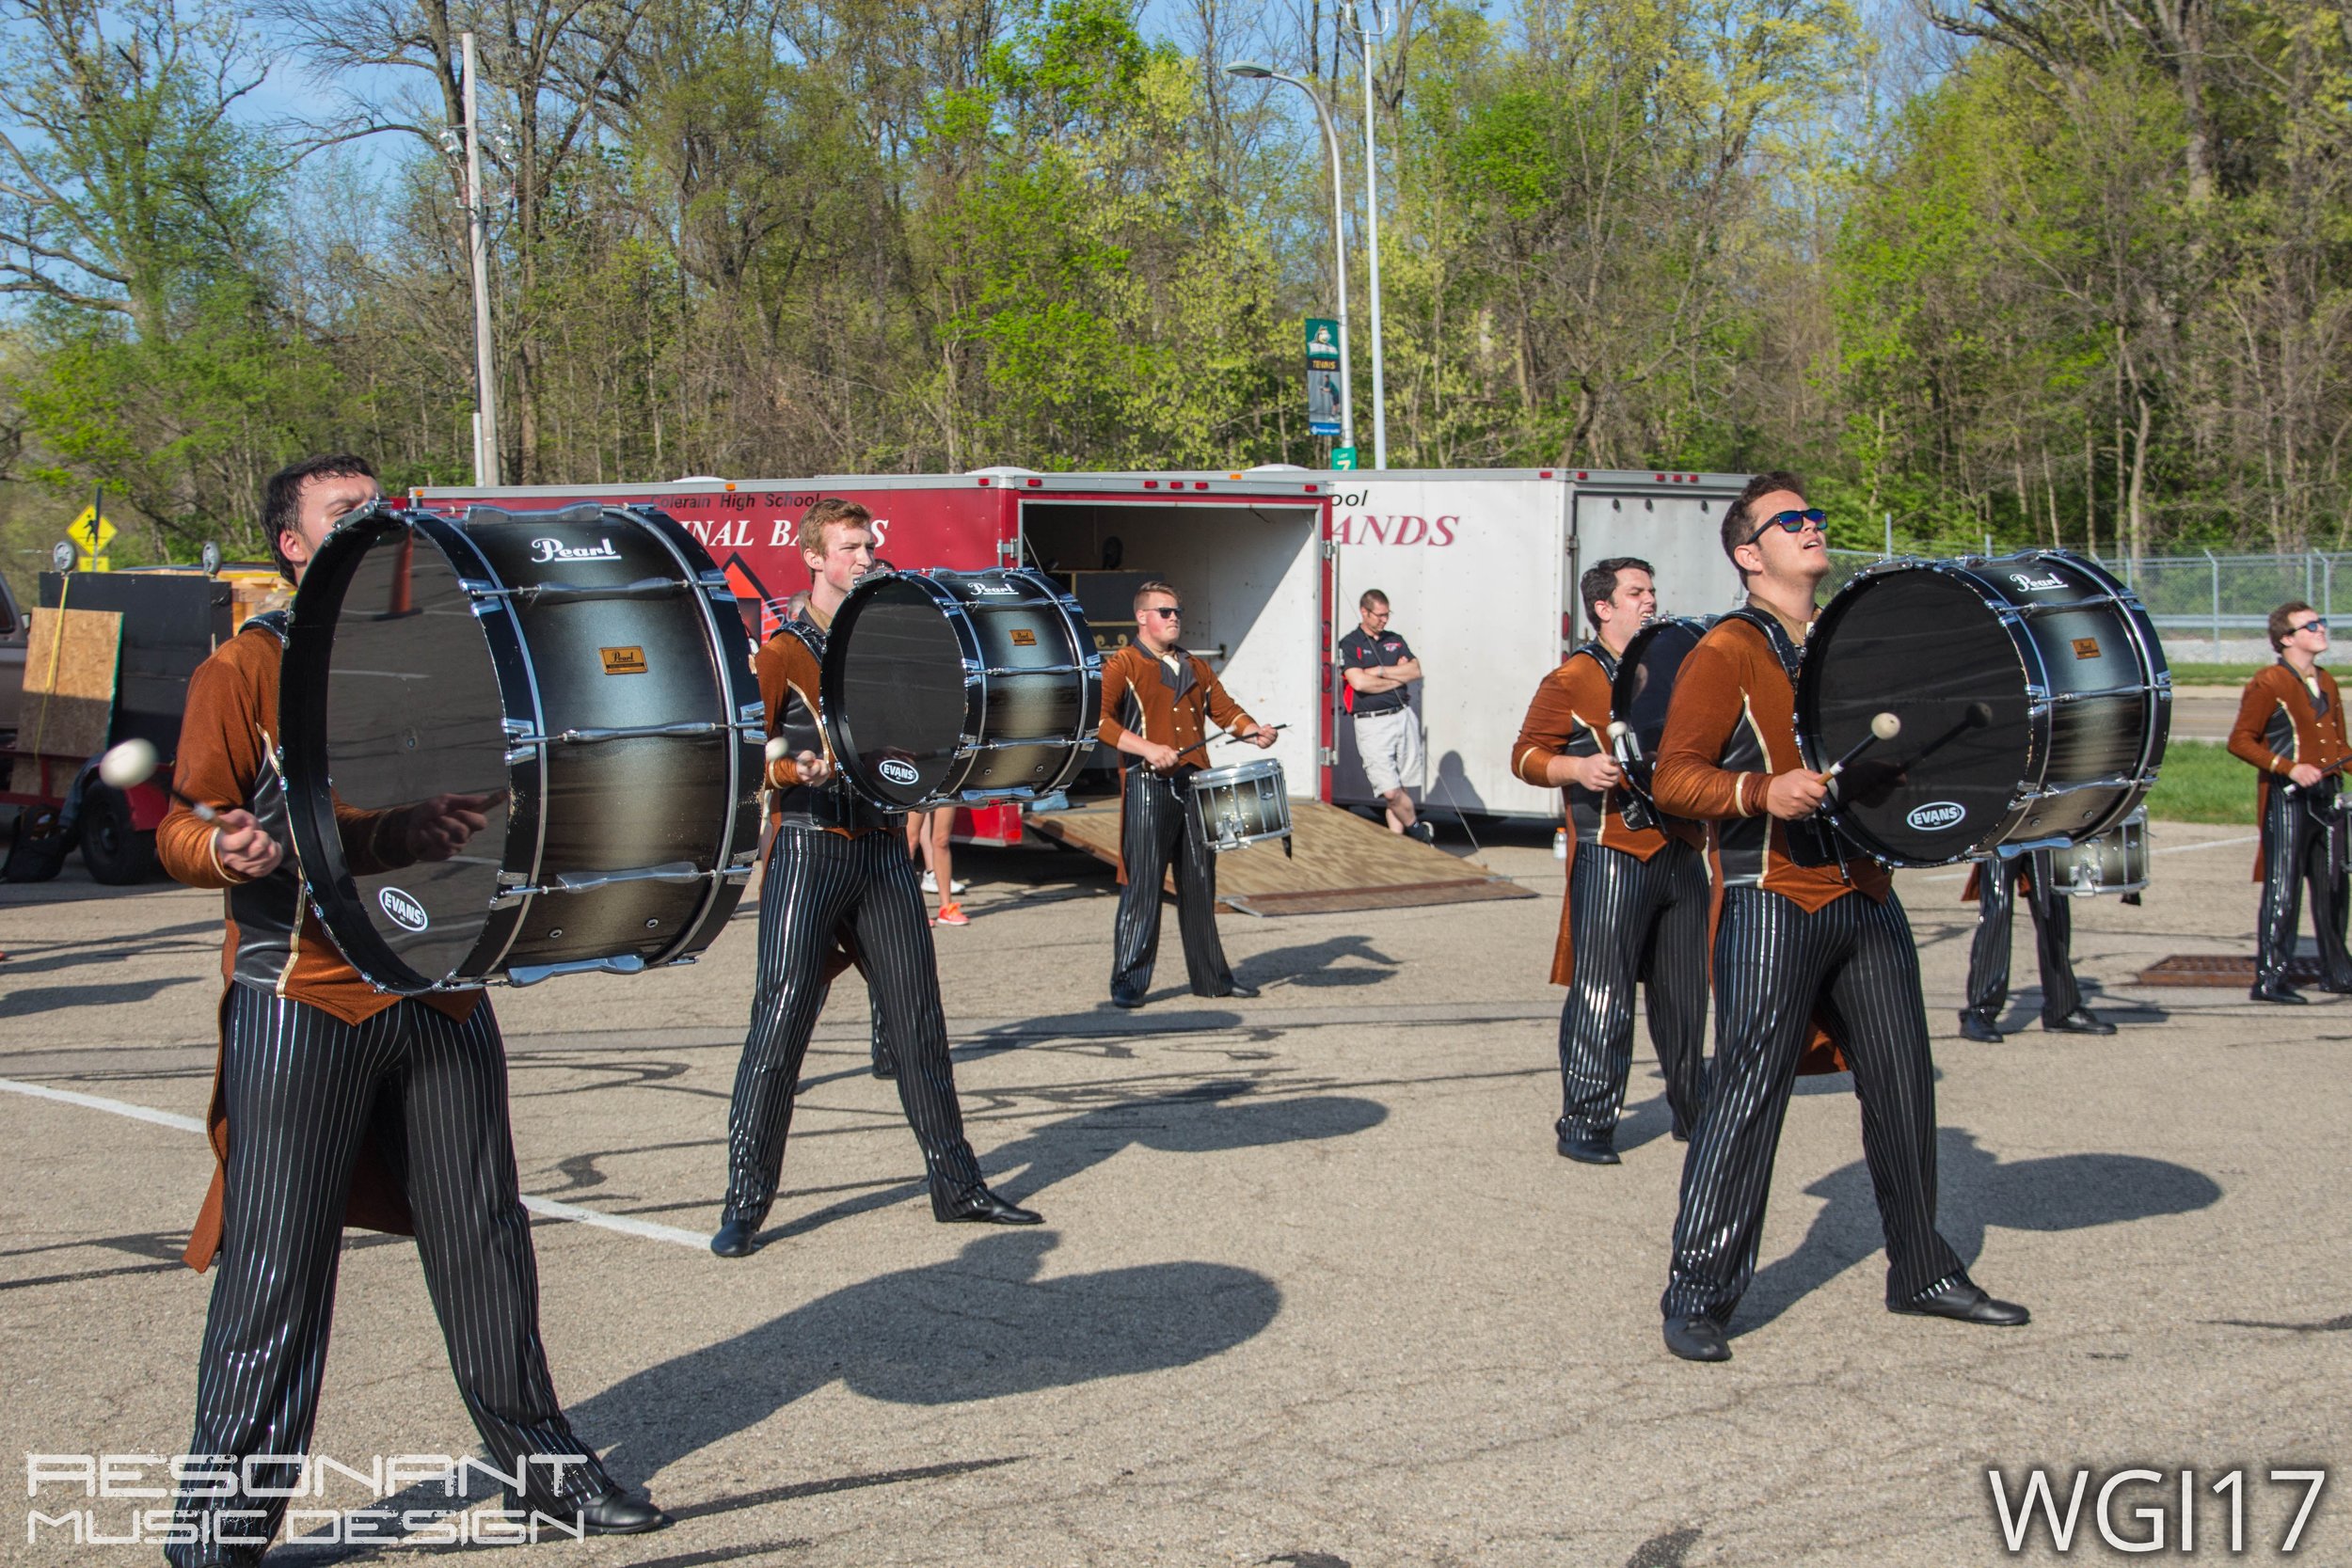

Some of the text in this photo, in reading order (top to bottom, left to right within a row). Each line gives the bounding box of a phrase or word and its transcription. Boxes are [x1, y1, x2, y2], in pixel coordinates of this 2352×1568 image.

[1337, 460, 1351, 470] 7
[720, 494, 755, 511] High
[764, 494, 820, 508] School
[532, 538, 621, 562] Pearl
[968, 582, 1019, 595] Pearl
[2010, 572, 2069, 593] Pearl
[612, 651, 634, 662] Pearl
[883, 764, 914, 781] EVANS
[1913, 807, 1958, 825] EVANS
[384, 892, 421, 926] EVANS
